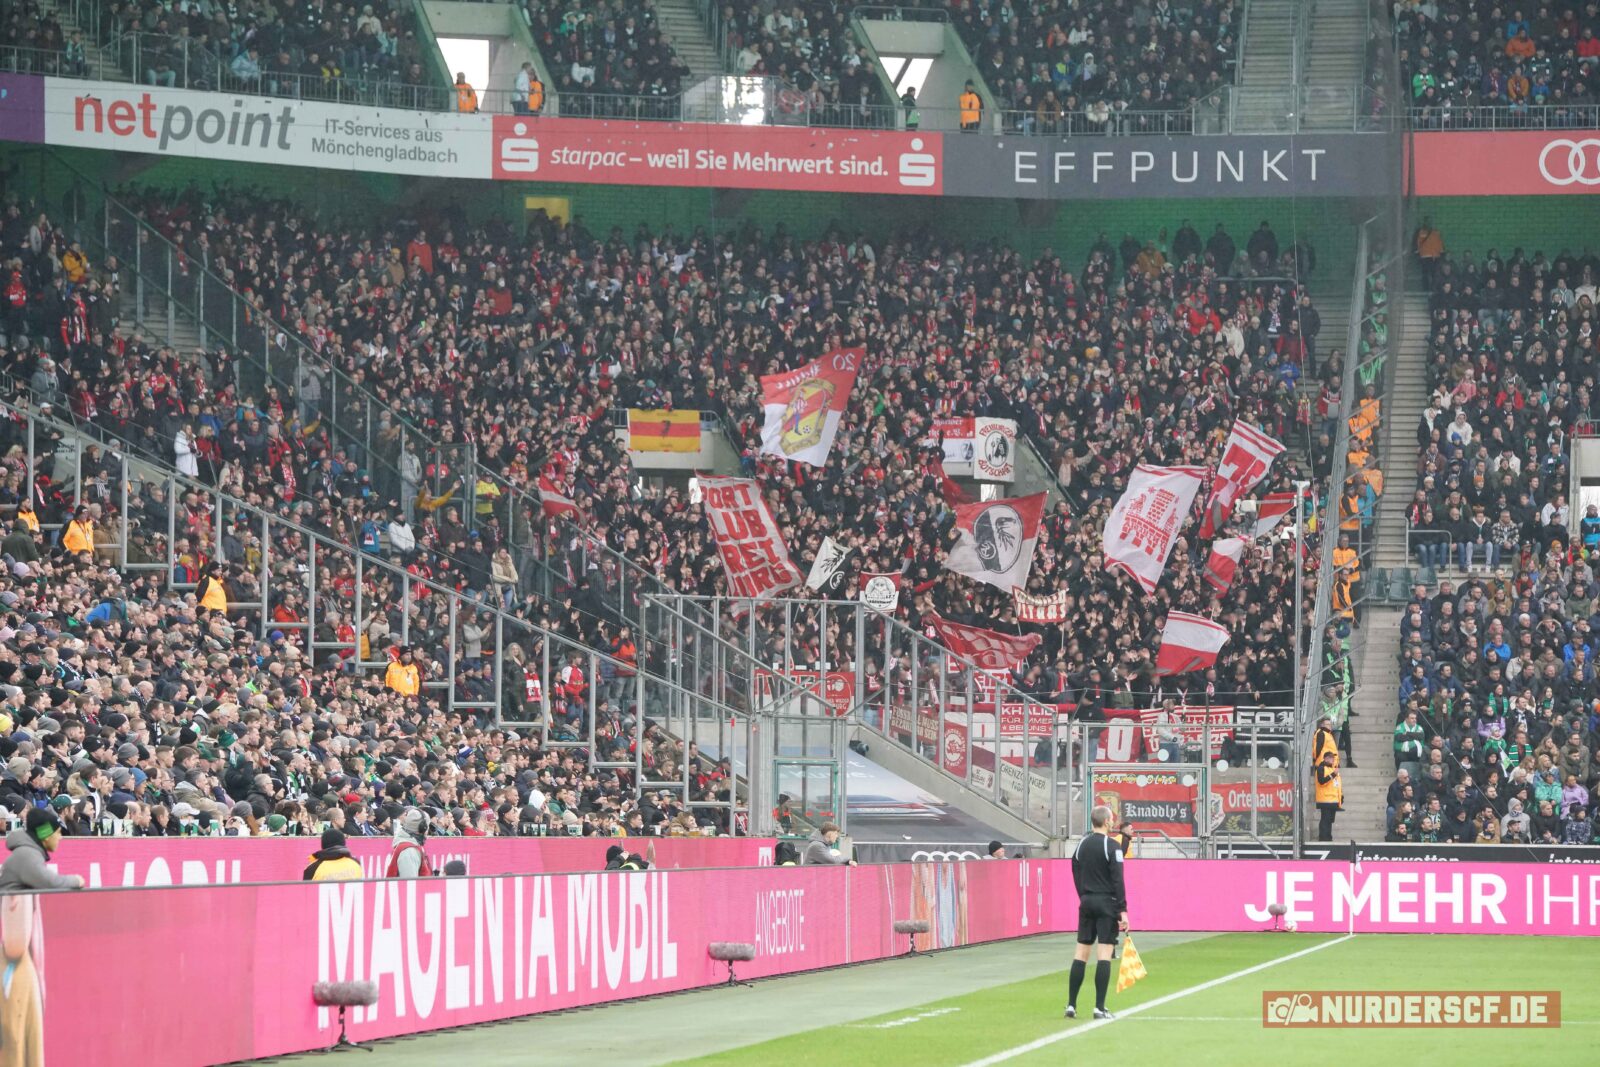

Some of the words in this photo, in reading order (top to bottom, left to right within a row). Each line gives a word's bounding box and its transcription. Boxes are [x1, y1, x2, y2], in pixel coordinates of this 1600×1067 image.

[74, 92, 295, 150] netpoint
[325, 118, 410, 141] IT-Services
[415, 128, 443, 143] aus
[311, 137, 458, 164] Mönchengladbach
[550, 146, 626, 168] starpac
[647, 149, 689, 170] weil
[695, 150, 727, 170] Sie
[733, 152, 832, 175] Mehrwert
[839, 155, 888, 176] sind.
[1014, 149, 1326, 183] EFFPUNKT
[1125, 803, 1187, 820] Knaddly's
[1244, 871, 1314, 922] JE
[1332, 871, 1507, 924] MEHR
[755, 889, 804, 956] ANGEBOTE
